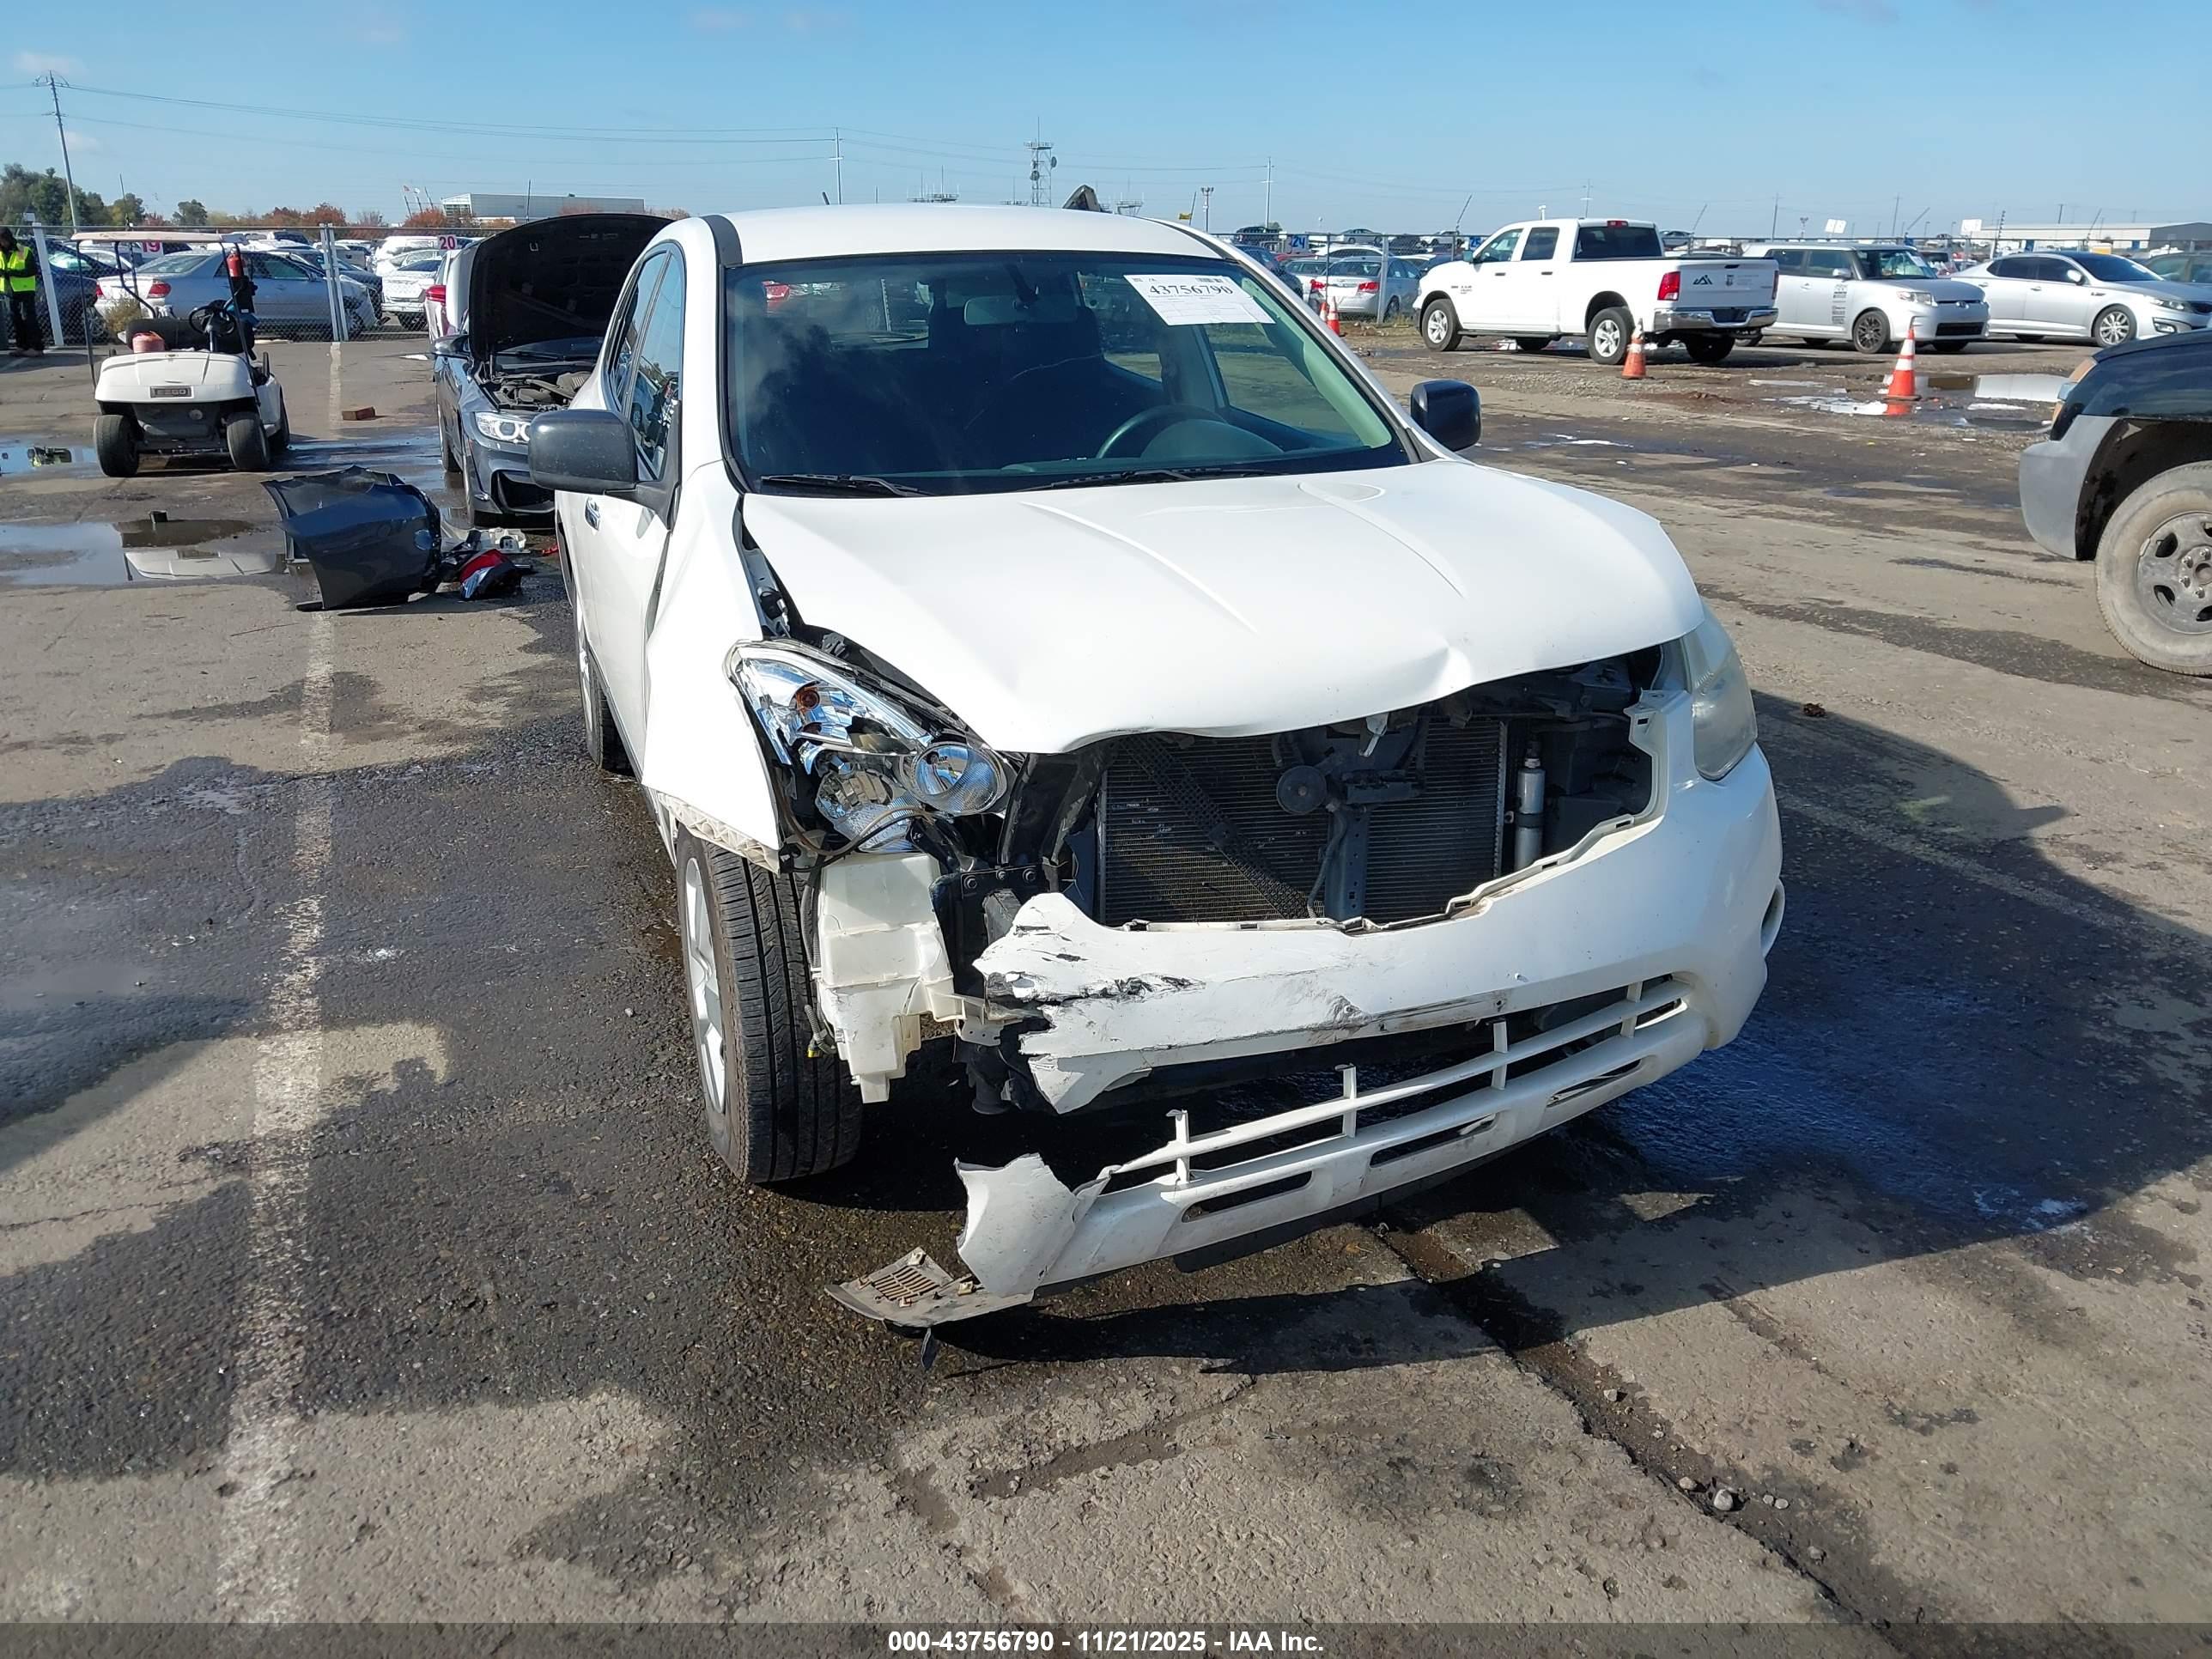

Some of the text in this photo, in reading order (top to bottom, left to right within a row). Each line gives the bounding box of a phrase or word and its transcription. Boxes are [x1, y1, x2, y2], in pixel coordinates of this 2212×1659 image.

[143, 240, 161, 252] 19
[439, 235, 456, 249] 20
[1291, 235, 1305, 249] 24
[1150, 285, 1233, 295] 43756790
